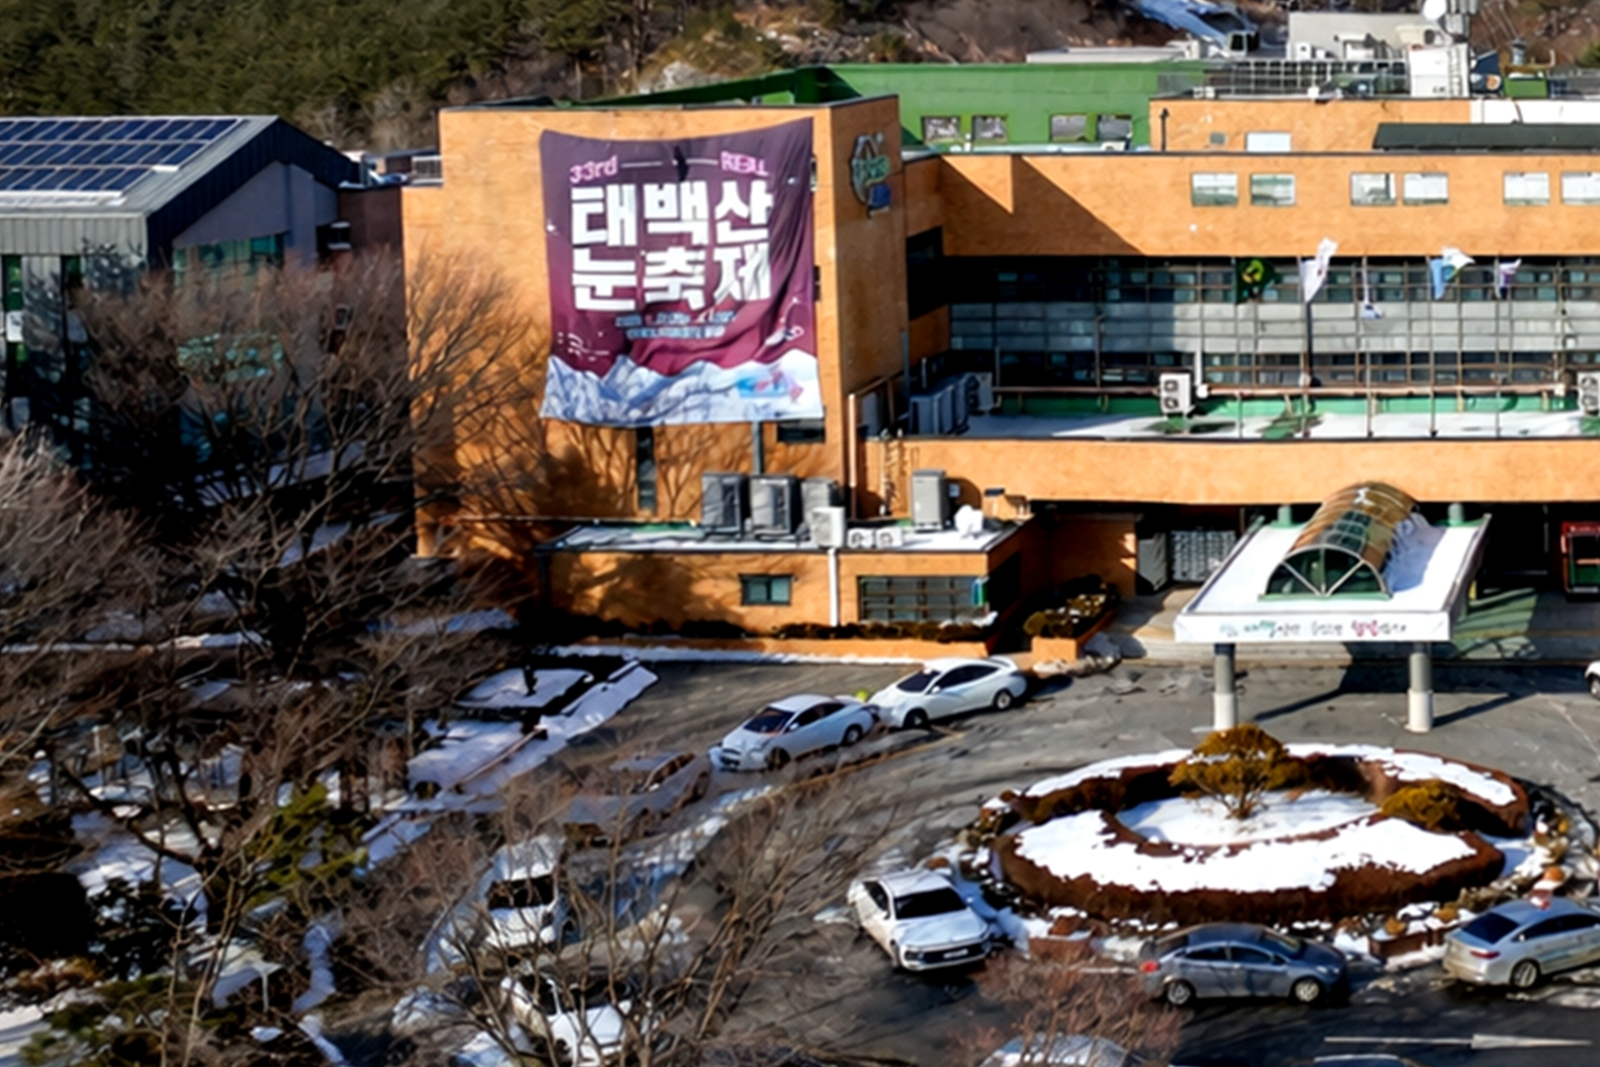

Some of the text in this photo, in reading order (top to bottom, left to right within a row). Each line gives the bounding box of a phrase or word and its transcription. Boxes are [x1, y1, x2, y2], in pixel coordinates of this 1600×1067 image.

[570, 155, 618, 183] 33rd
[570, 180, 774, 246] 태백산
[571, 243, 772, 311] 눈축제
